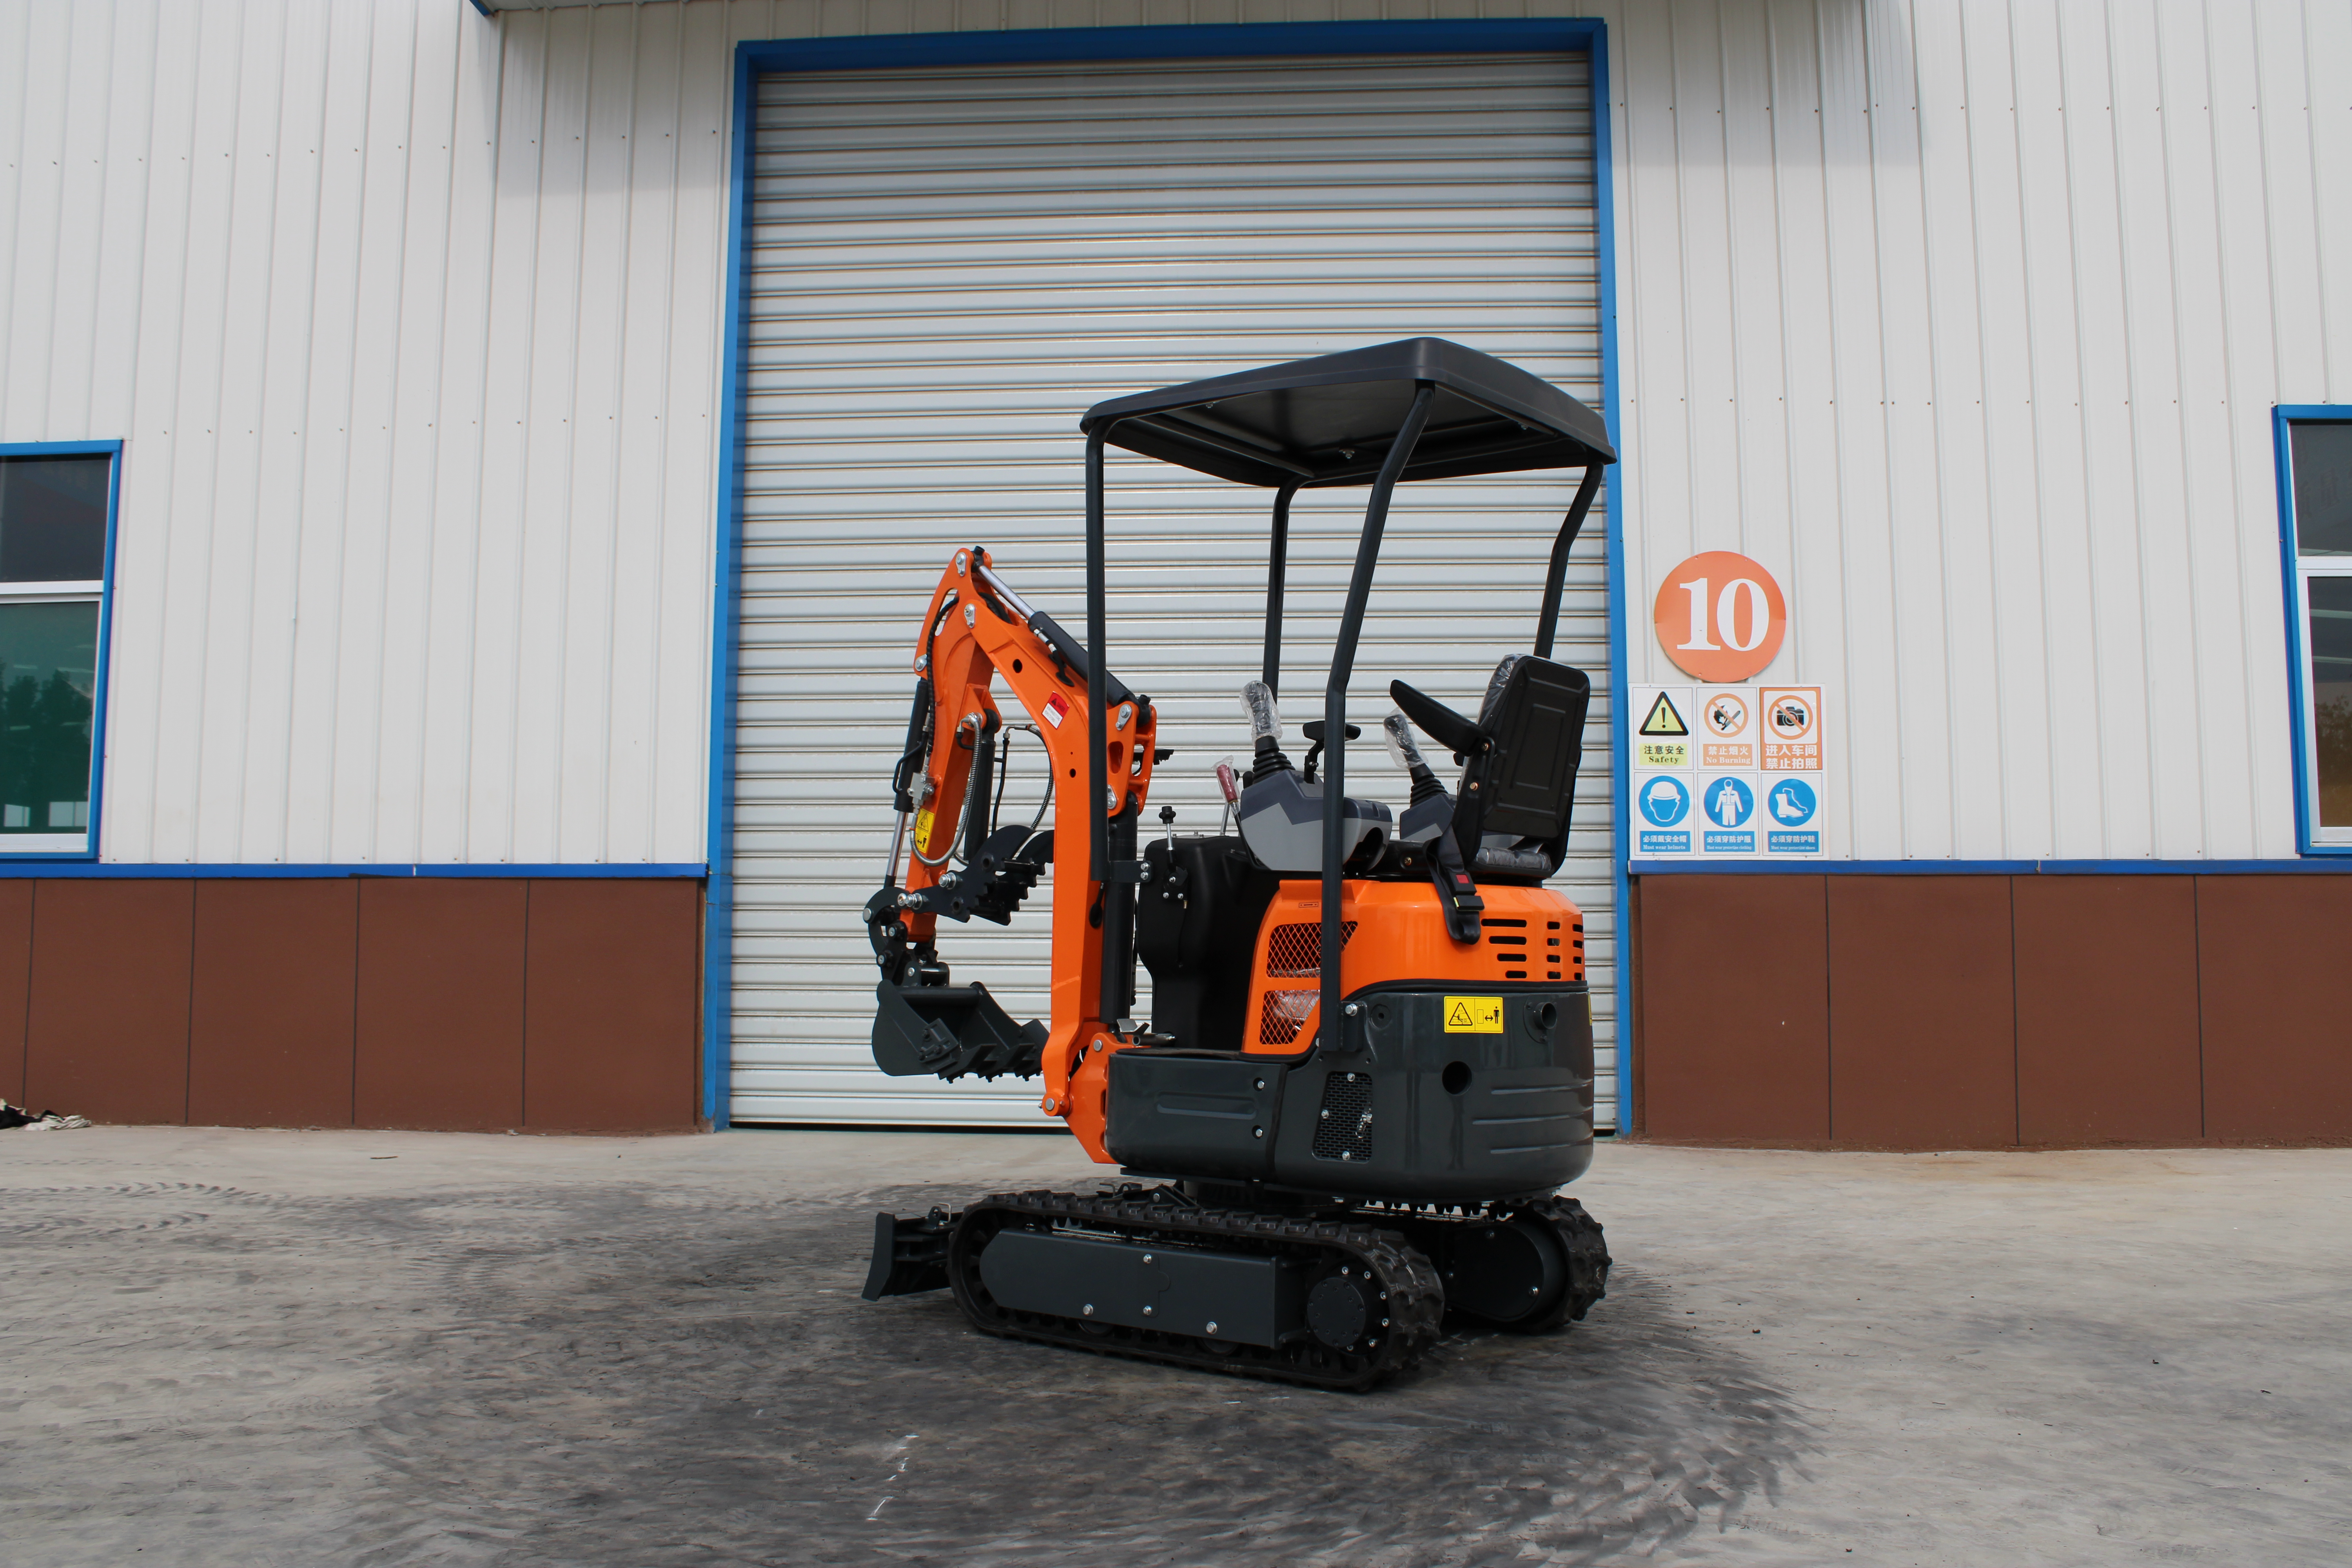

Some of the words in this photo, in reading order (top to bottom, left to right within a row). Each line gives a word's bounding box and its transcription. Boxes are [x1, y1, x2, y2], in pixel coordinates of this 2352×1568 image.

[1677, 577, 1769, 652] 10
[1644, 745, 1684, 755] 注意安全
[1708, 746, 1749, 755] 禁止烟火
[1765, 744, 1817, 756] 进入车间
[1648, 756, 1679, 764] Safety
[1766, 757, 1818, 769] 禁止拍照
